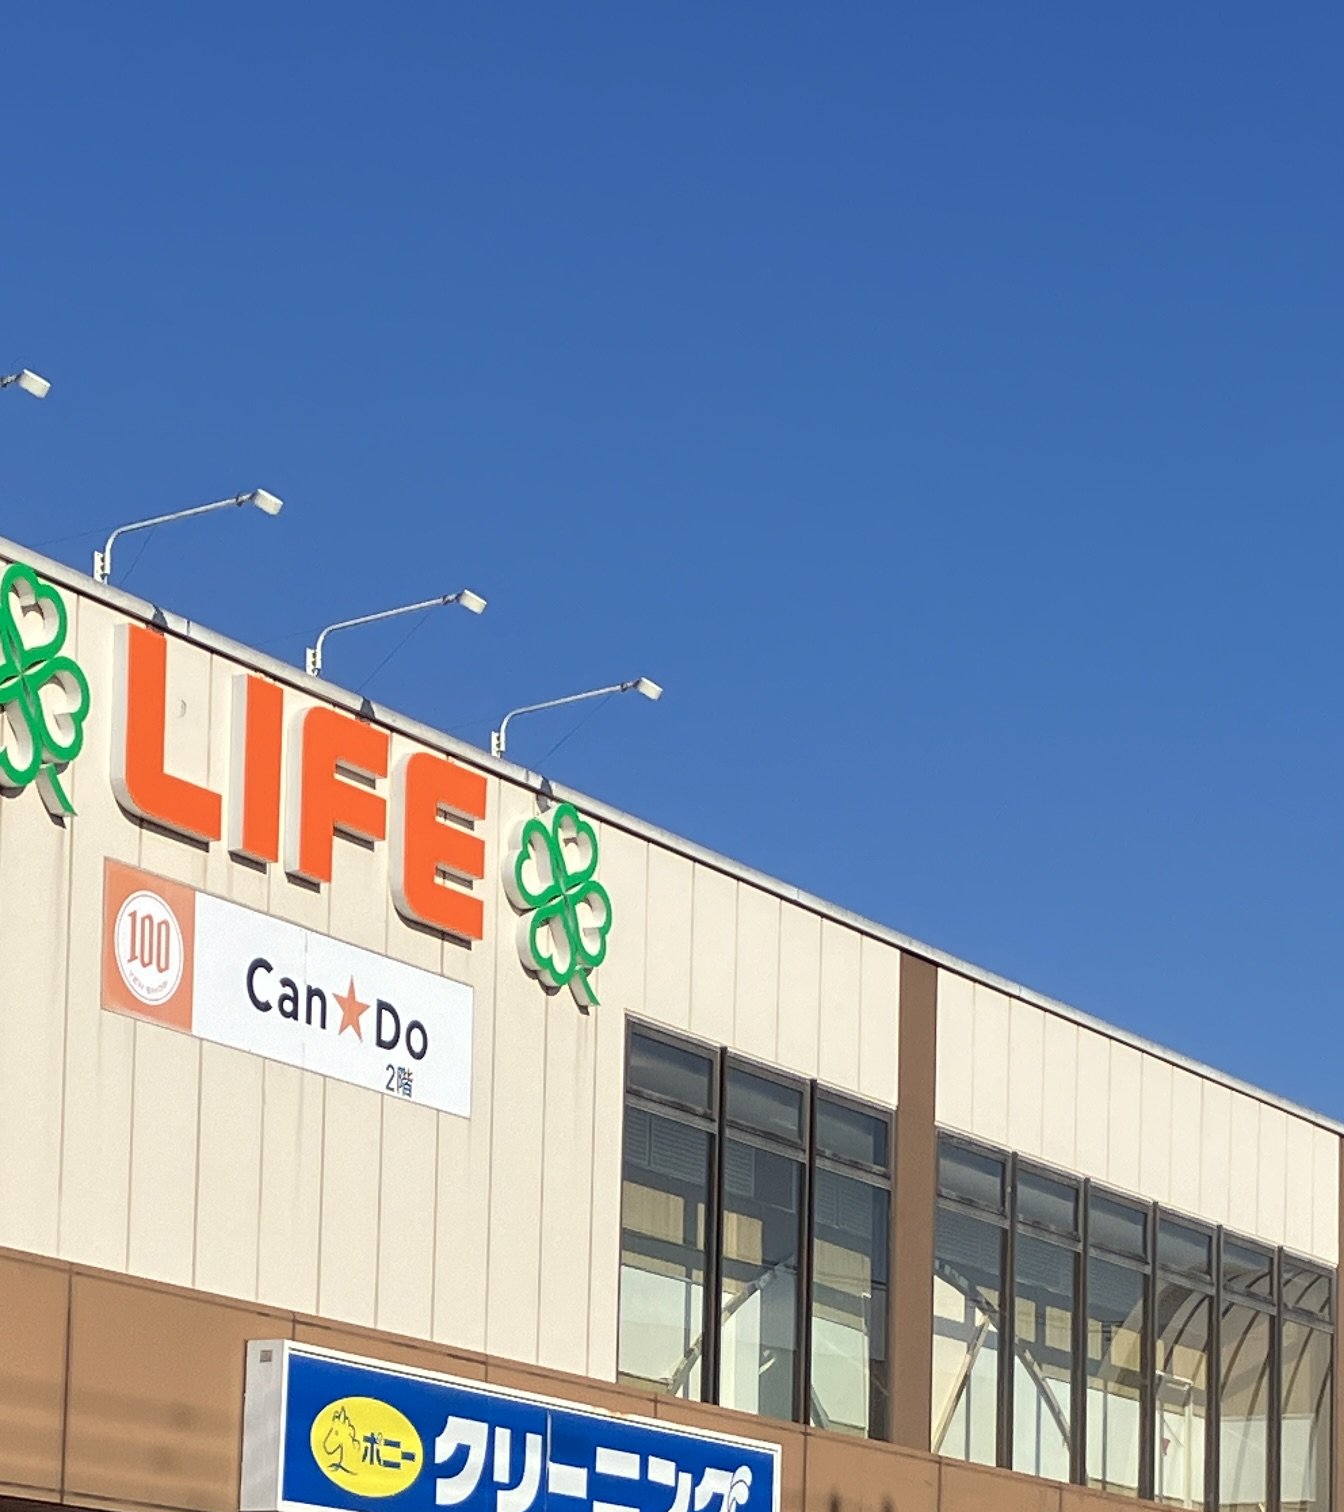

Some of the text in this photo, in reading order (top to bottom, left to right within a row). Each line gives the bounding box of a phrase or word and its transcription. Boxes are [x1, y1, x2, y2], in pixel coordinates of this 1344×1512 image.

[113, 622, 488, 942] LIFE
[127, 909, 171, 974] 100
[385, 1063, 413, 1098] 2階
[362, 1431, 416, 1470] ポニー
